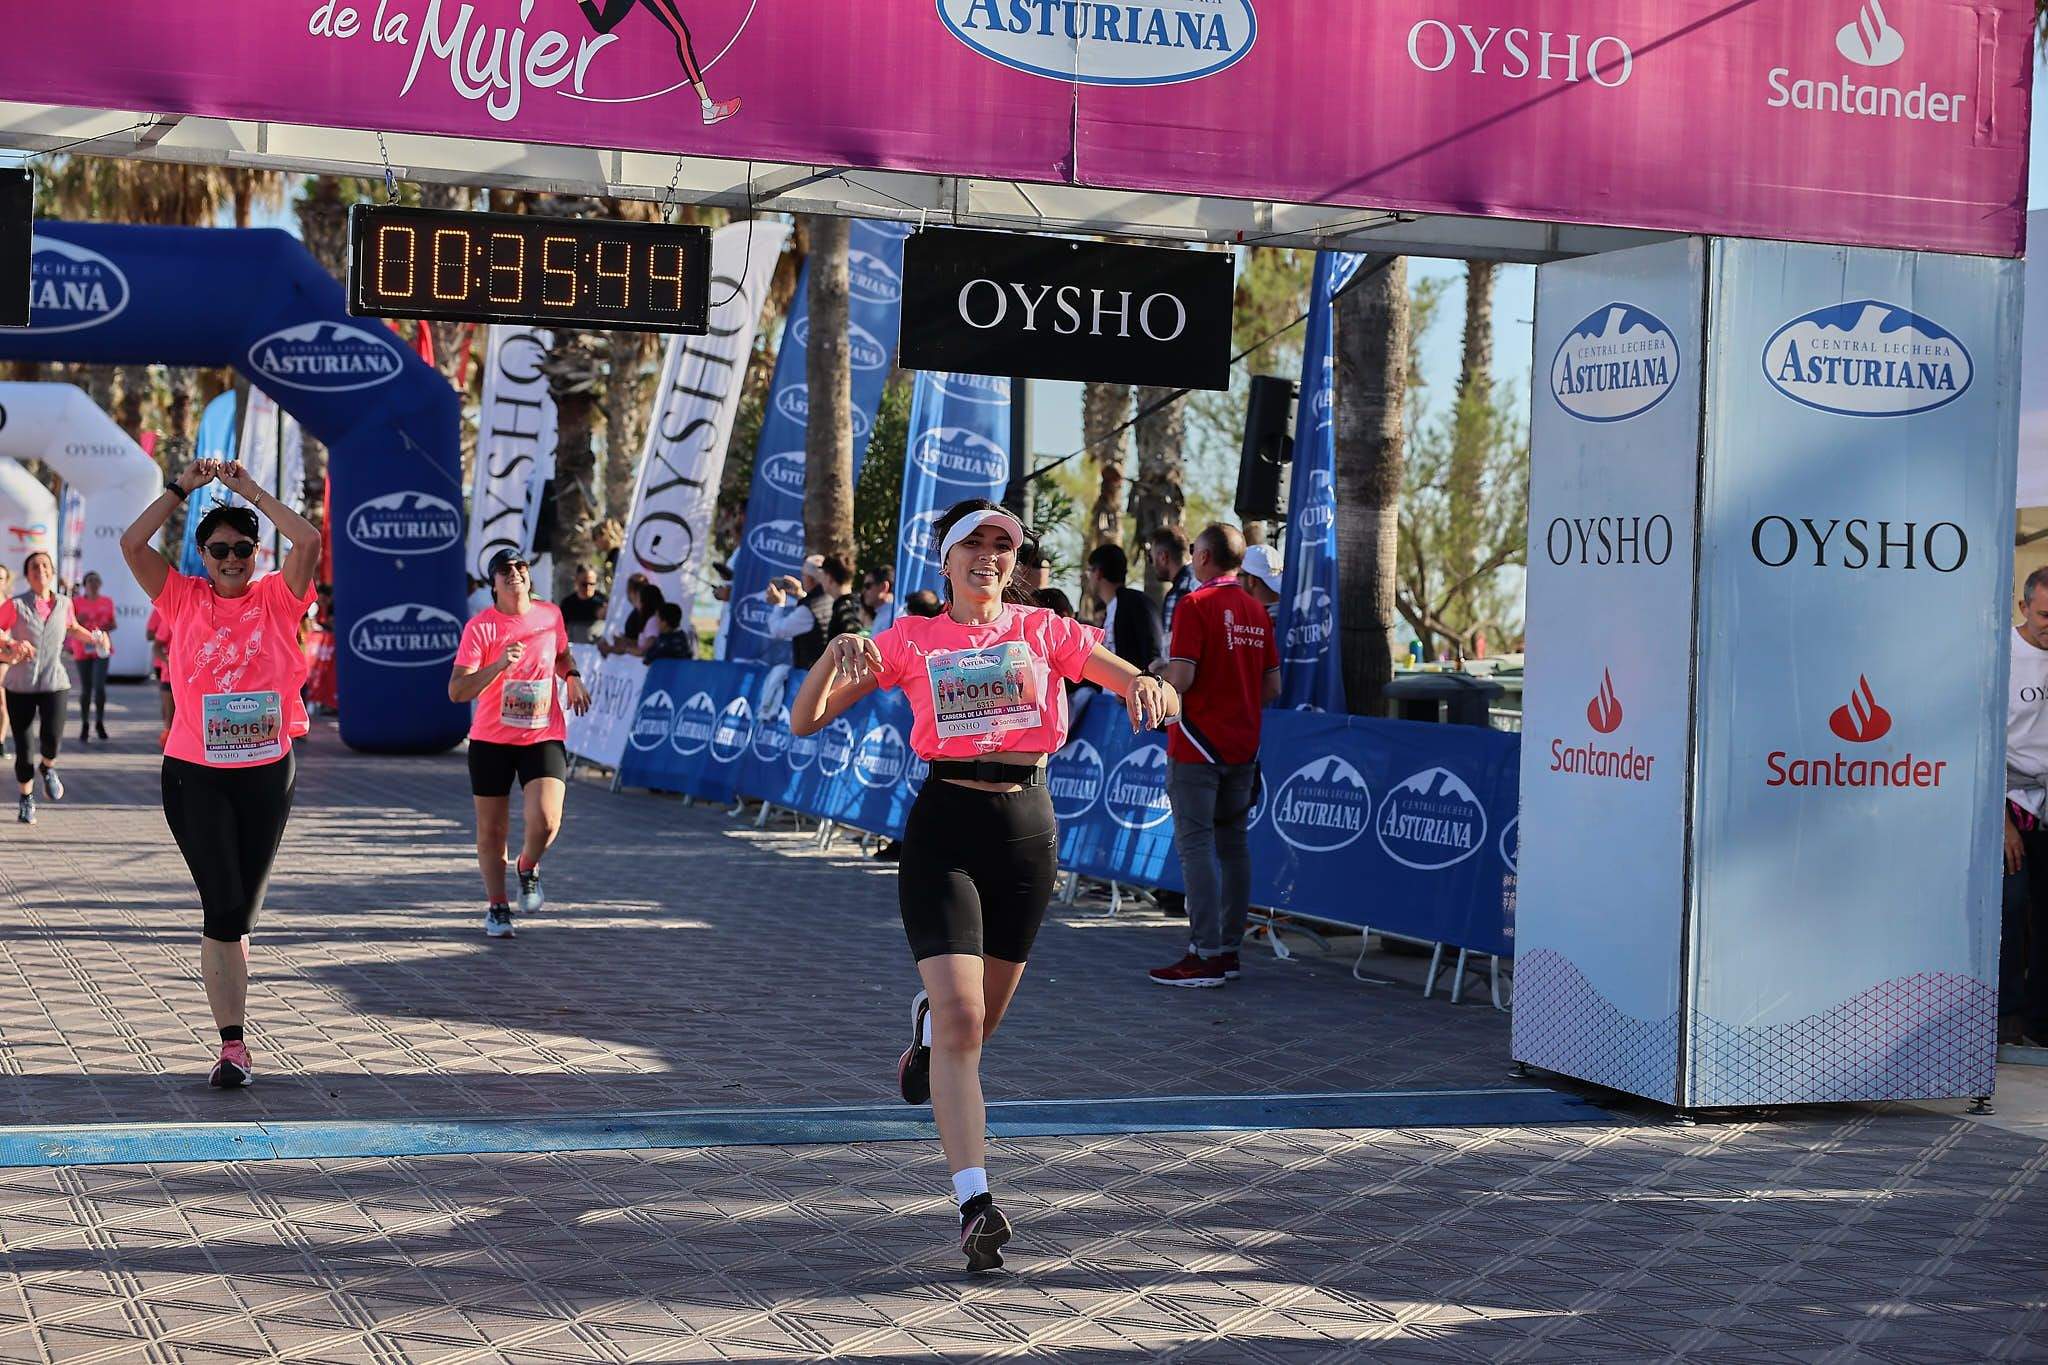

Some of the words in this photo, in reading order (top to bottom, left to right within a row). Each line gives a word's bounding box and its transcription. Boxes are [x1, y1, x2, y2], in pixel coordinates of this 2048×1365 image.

[308, 0, 361, 38] de
[372, 0, 409, 45] la
[962, 0, 1232, 51] ASTURIANA
[399, 0, 620, 121] Mujer
[1408, 19, 1633, 87] OYSHO
[1767, 67, 1966, 123] Santander
[378, 226, 683, 310] 00:35:44
[957, 279, 1186, 341] OYSHO
[262, 347, 393, 374] ASTURIANA
[1578, 345, 1617, 360] CENTRAL
[1622, 339, 1665, 354] LECHERA
[1777, 339, 1956, 391] ASTURIANA
[1811, 338, 1877, 353] CENTRAL
[1884, 343, 1951, 357] LECHERA
[1558, 352, 1669, 395] ASTURIANA
[632, 275, 750, 573] OYSHO
[919, 439, 1003, 480] ASTURIANA
[1547, 514, 1672, 565] OYSHO
[1752, 516, 1968, 572] OYSHO
[967, 680, 1004, 698] 016
[230, 723, 260, 736] 016
[942, 713, 967, 721] CARRERA
[1006, 704, 1032, 714] VALENCIA
[948, 721, 980, 732] OYSHO
[999, 717, 1029, 726] Santander
[1551, 739, 1655, 781] Santander
[1767, 751, 1947, 787] Santander
[1277, 787, 1361, 830] ASTURIANA
[1381, 799, 1472, 849] ASTURIANA
